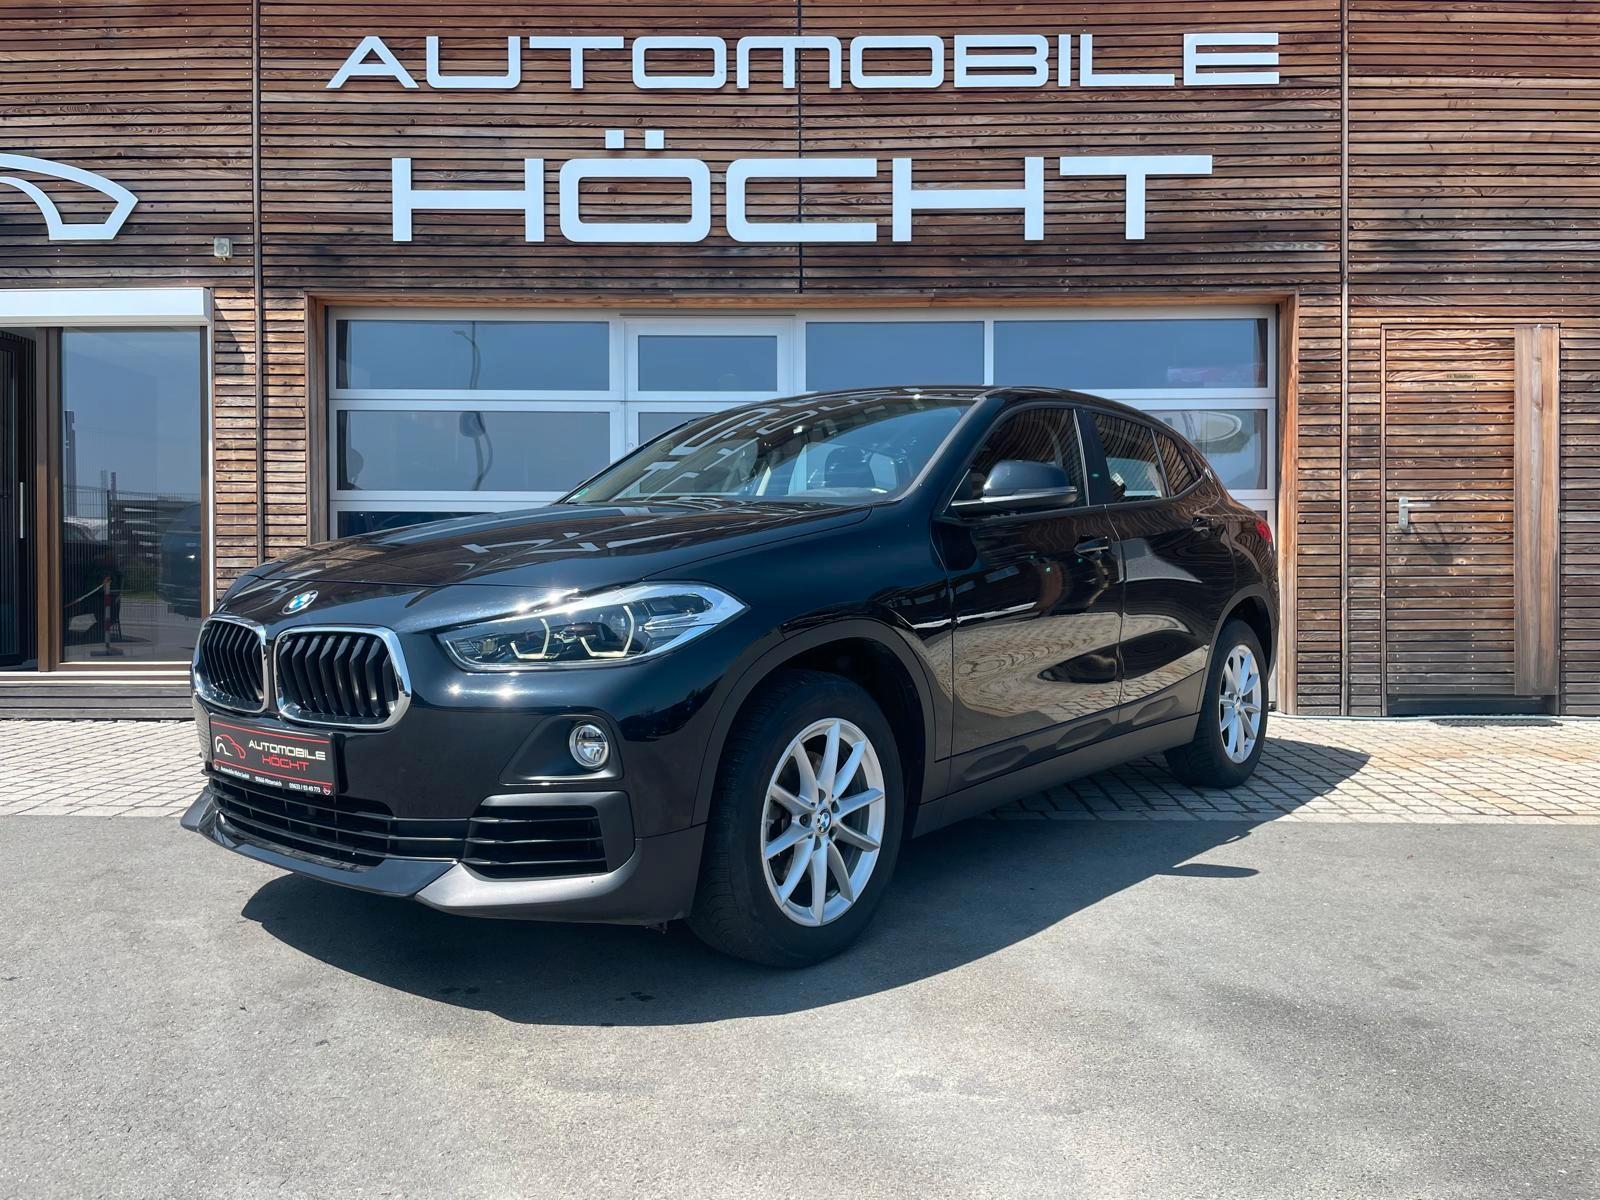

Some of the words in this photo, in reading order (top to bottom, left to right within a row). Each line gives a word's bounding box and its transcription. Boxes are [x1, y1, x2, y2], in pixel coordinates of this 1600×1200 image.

[325, 33, 1280, 90] AUTOMOBILE
[391, 129, 1213, 243] HÖCHT
[248, 739, 326, 761] AUTOMOBILE
[262, 754, 309, 771] HÖCHT
